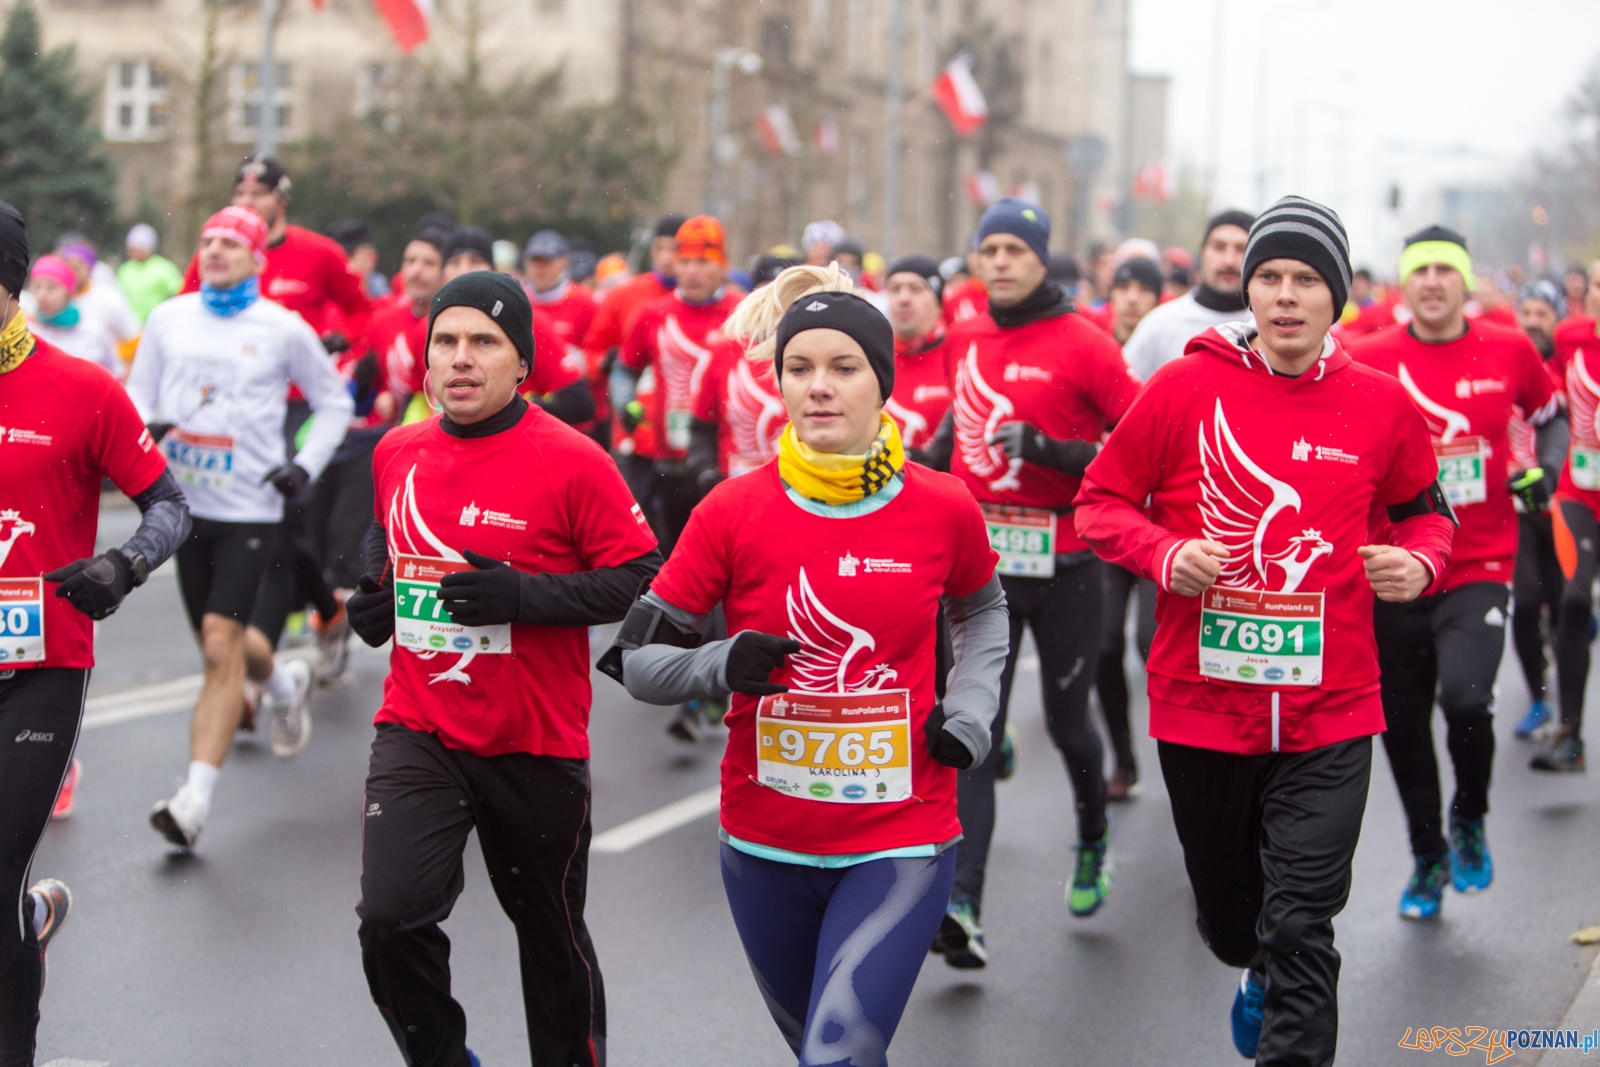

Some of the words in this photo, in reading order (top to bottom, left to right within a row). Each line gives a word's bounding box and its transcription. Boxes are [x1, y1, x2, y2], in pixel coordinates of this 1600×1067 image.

[1315, 445, 1323, 460] 1
[1440, 458, 1474, 482] 25
[481, 509, 489, 524] 1
[988, 529, 1043, 552] 498
[863, 557, 872, 573] 1
[408, 587, 453, 619] 77
[1265, 602, 1314, 612] RunPoland.org
[430, 624, 464, 634] Krzysztof
[1216, 618, 1304, 654] 7691
[1245, 656, 1269, 664] Jacek
[841, 705, 899, 716] RunPoland.org
[762, 735, 773, 747] D
[778, 728, 895, 767] 9765
[809, 767, 867, 778] KAROLINA
